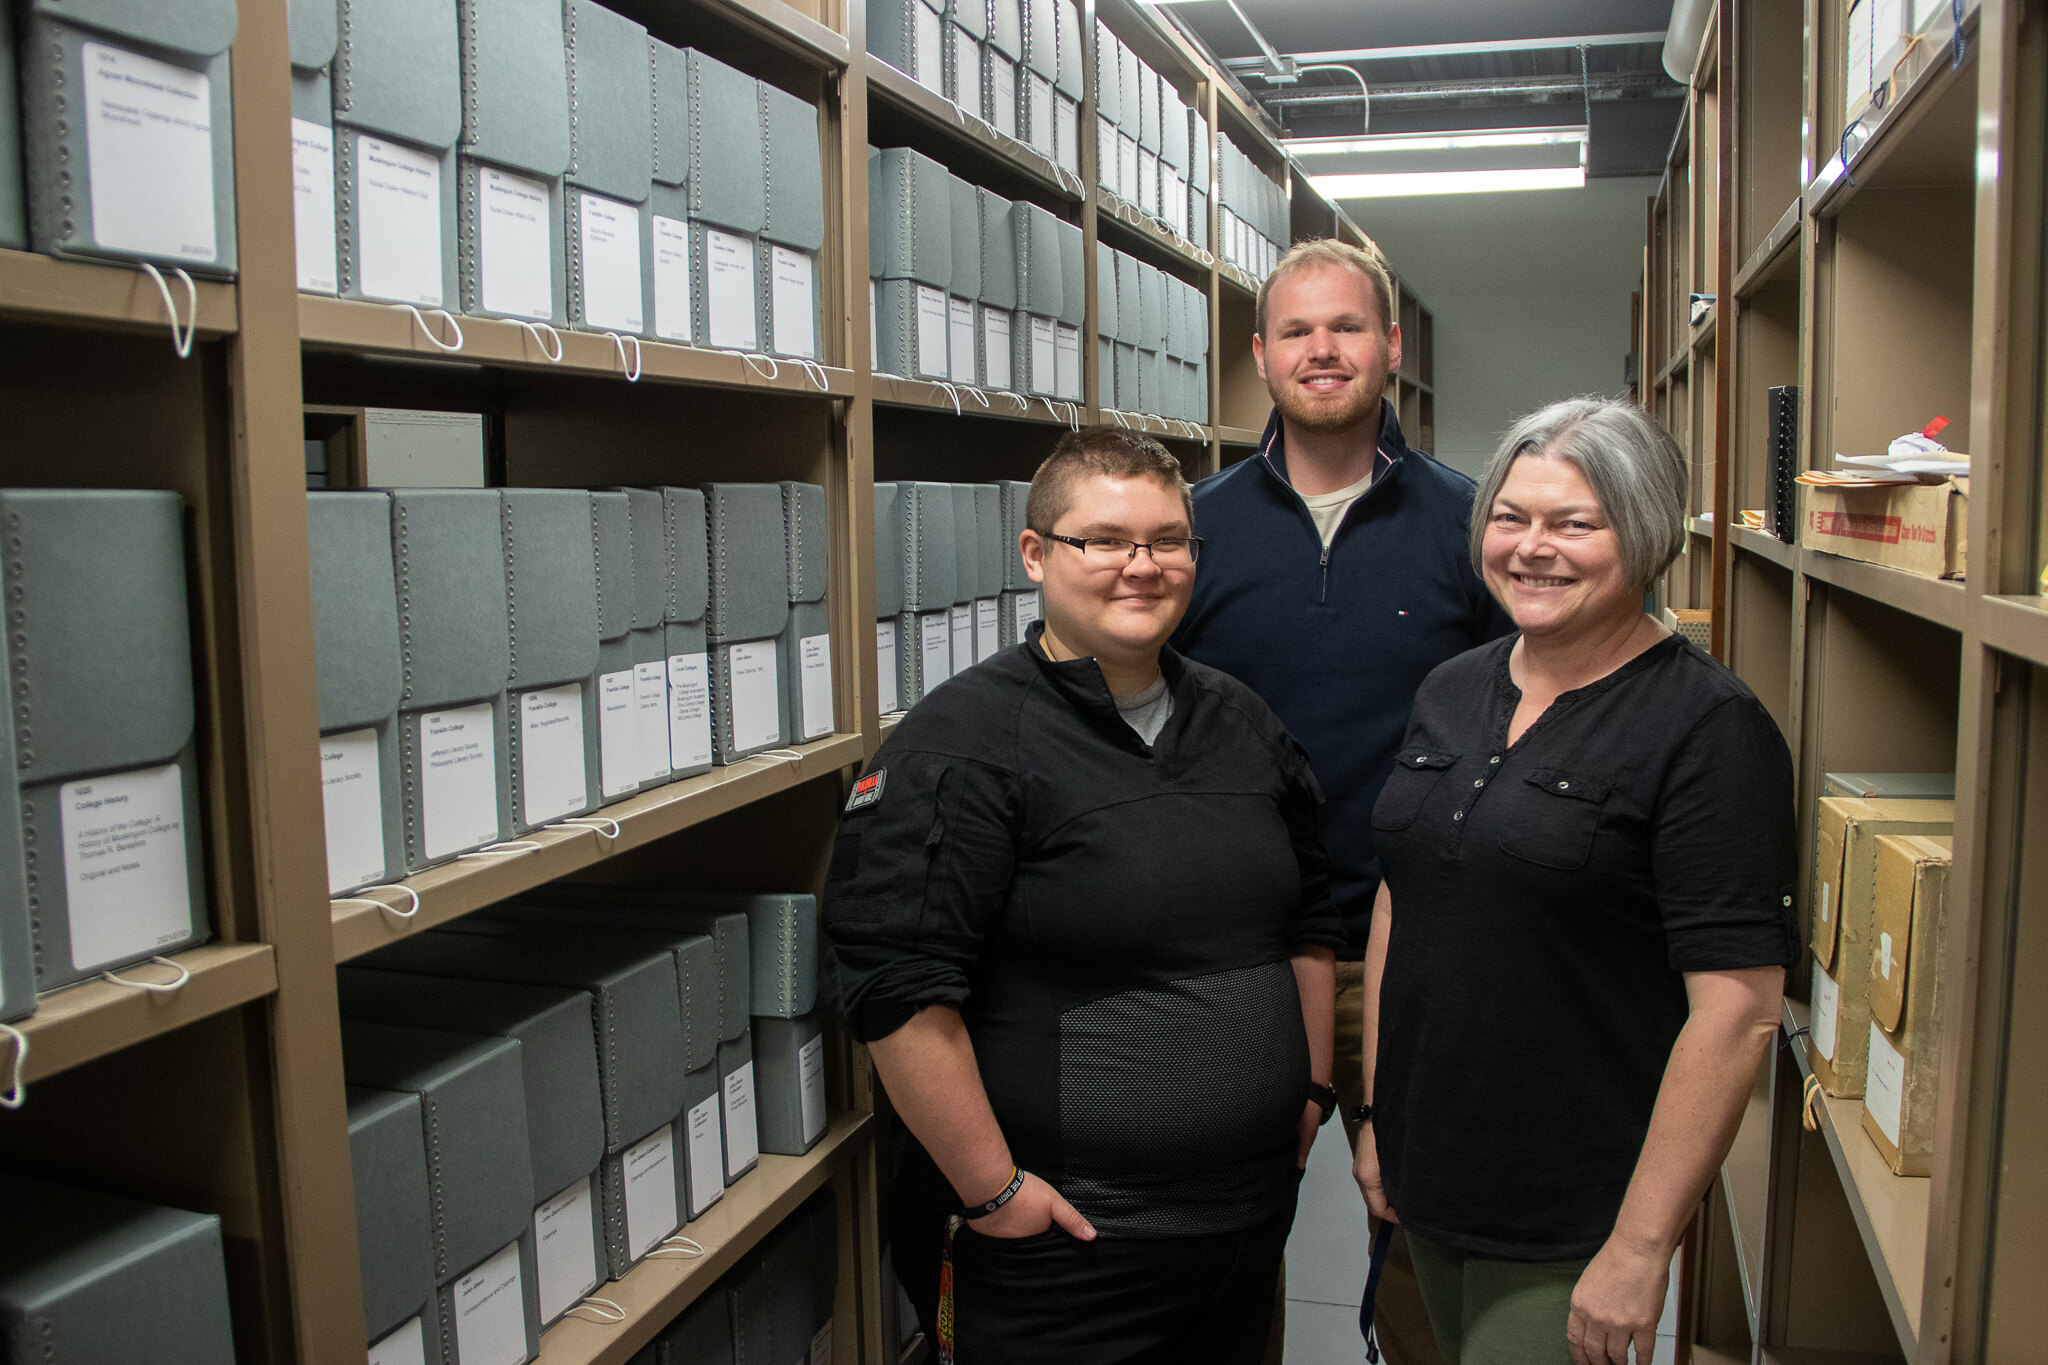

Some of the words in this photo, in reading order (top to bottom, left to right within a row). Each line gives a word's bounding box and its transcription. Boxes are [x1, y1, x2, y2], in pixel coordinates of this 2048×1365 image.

[397, 161, 414, 172] College
[430, 727, 448, 735] Franklin
[448, 724, 465, 732] College
[324, 753, 343, 761] College
[75, 800, 103, 810] College
[103, 795, 128, 805] History
[148, 825, 170, 834] College
[1010, 1180, 1021, 1192] THE
